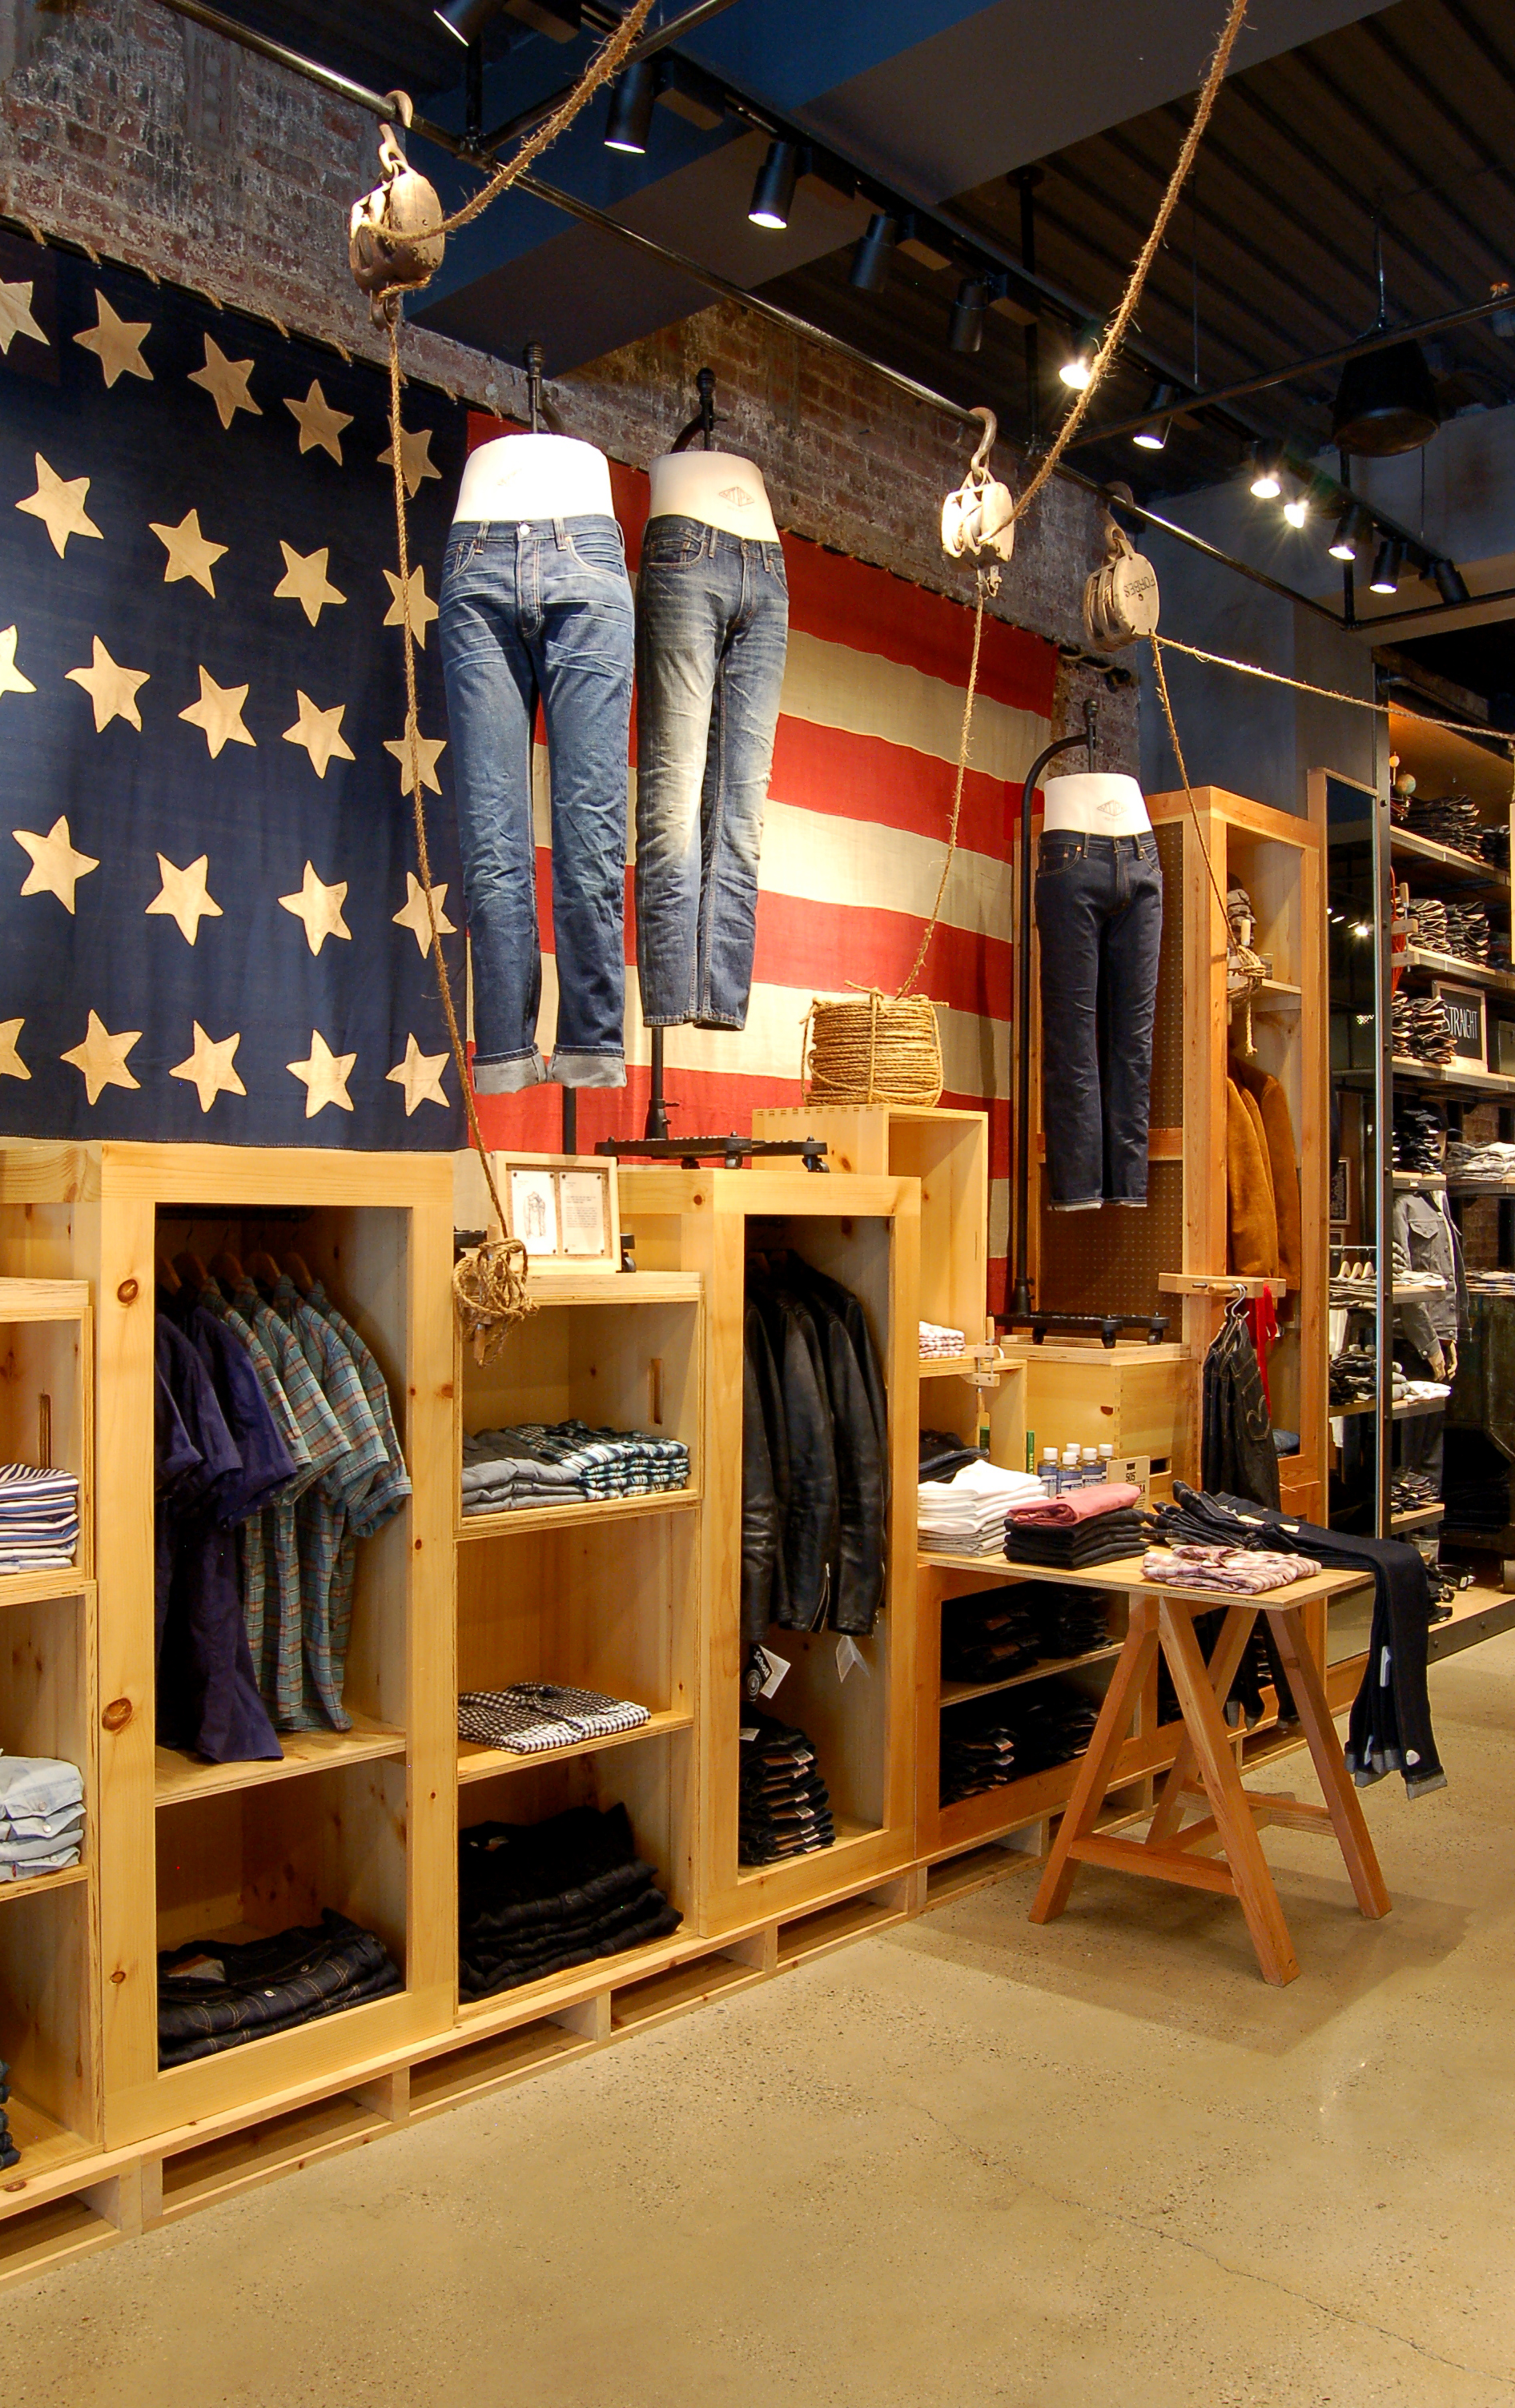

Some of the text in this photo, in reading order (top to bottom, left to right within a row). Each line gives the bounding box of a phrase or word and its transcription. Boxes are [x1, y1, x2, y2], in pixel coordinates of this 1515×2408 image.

[1123, 576, 1155, 597] FORBES
[1441, 1004, 1477, 1039] STRAIGHT
[1125, 1471, 1136, 1482] 505
